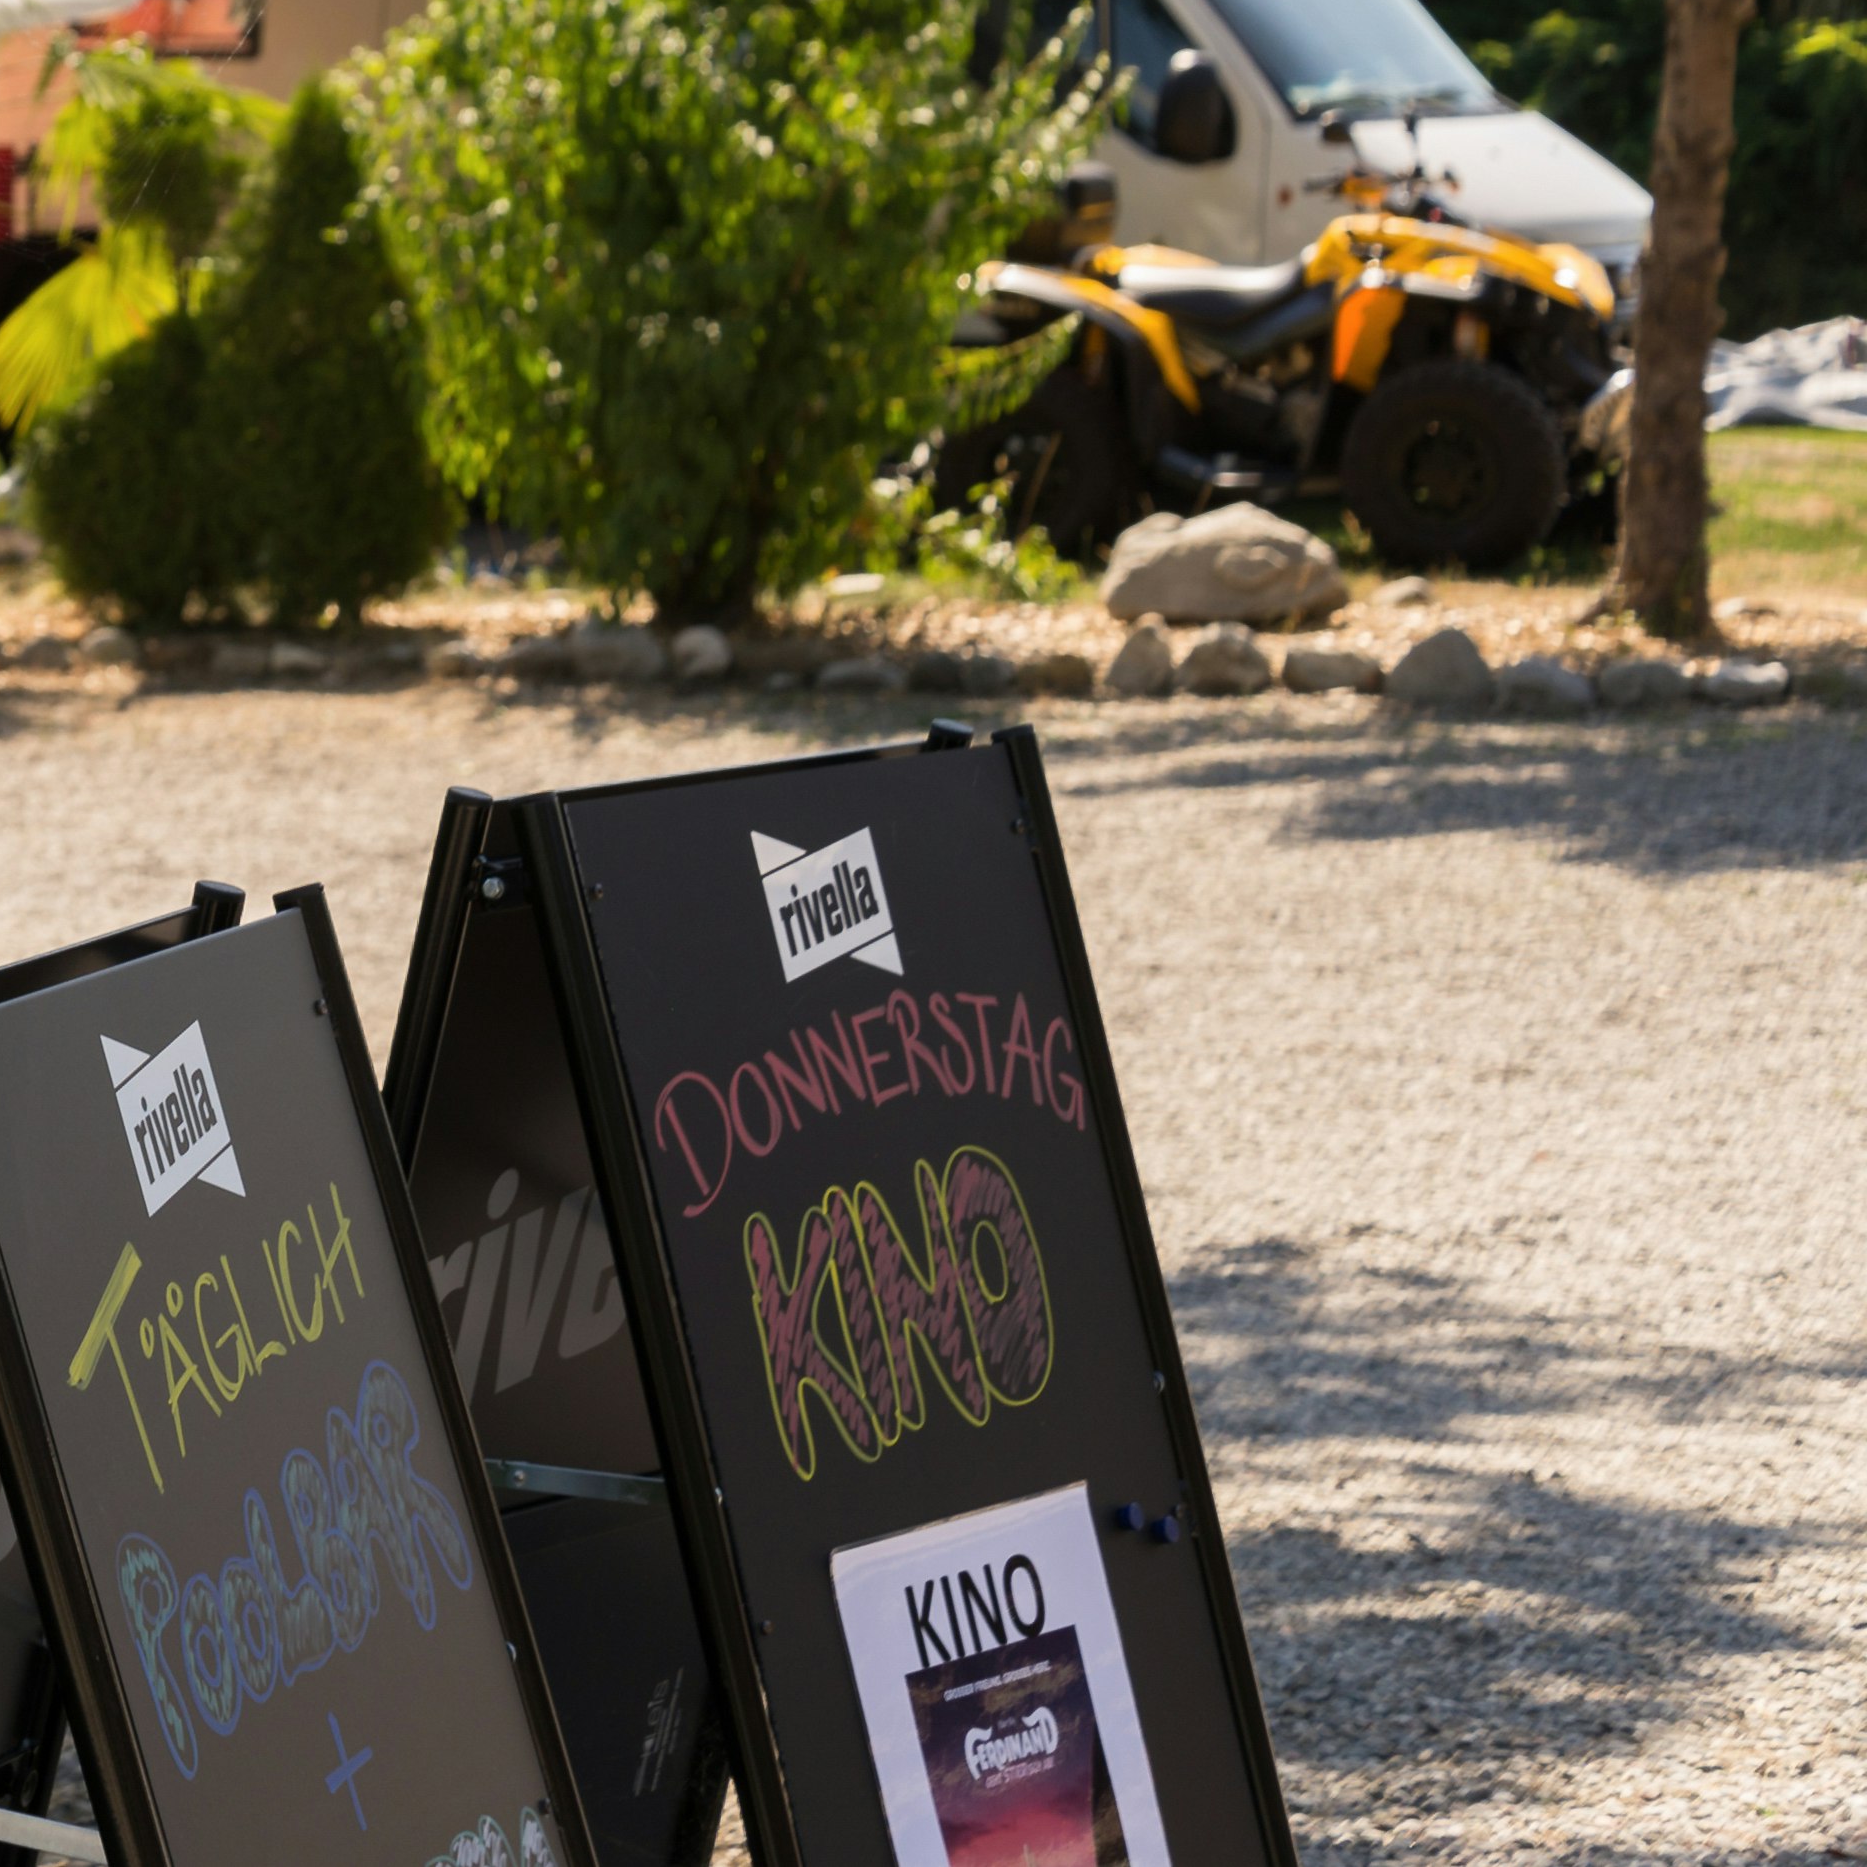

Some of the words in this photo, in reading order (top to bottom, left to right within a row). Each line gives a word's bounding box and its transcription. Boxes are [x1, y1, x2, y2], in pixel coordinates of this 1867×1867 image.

[778, 860, 880, 958] rivella
[134, 1062, 218, 1185] rivella
[654, 989, 1086, 1218] DONNERSTAG
[67, 1181, 365, 1495] TÄGLICH
[742, 1144, 1055, 1482] KINO
[904, 1553, 1046, 1668] KINO
[964, 1706, 1059, 1781] FERDINAND
